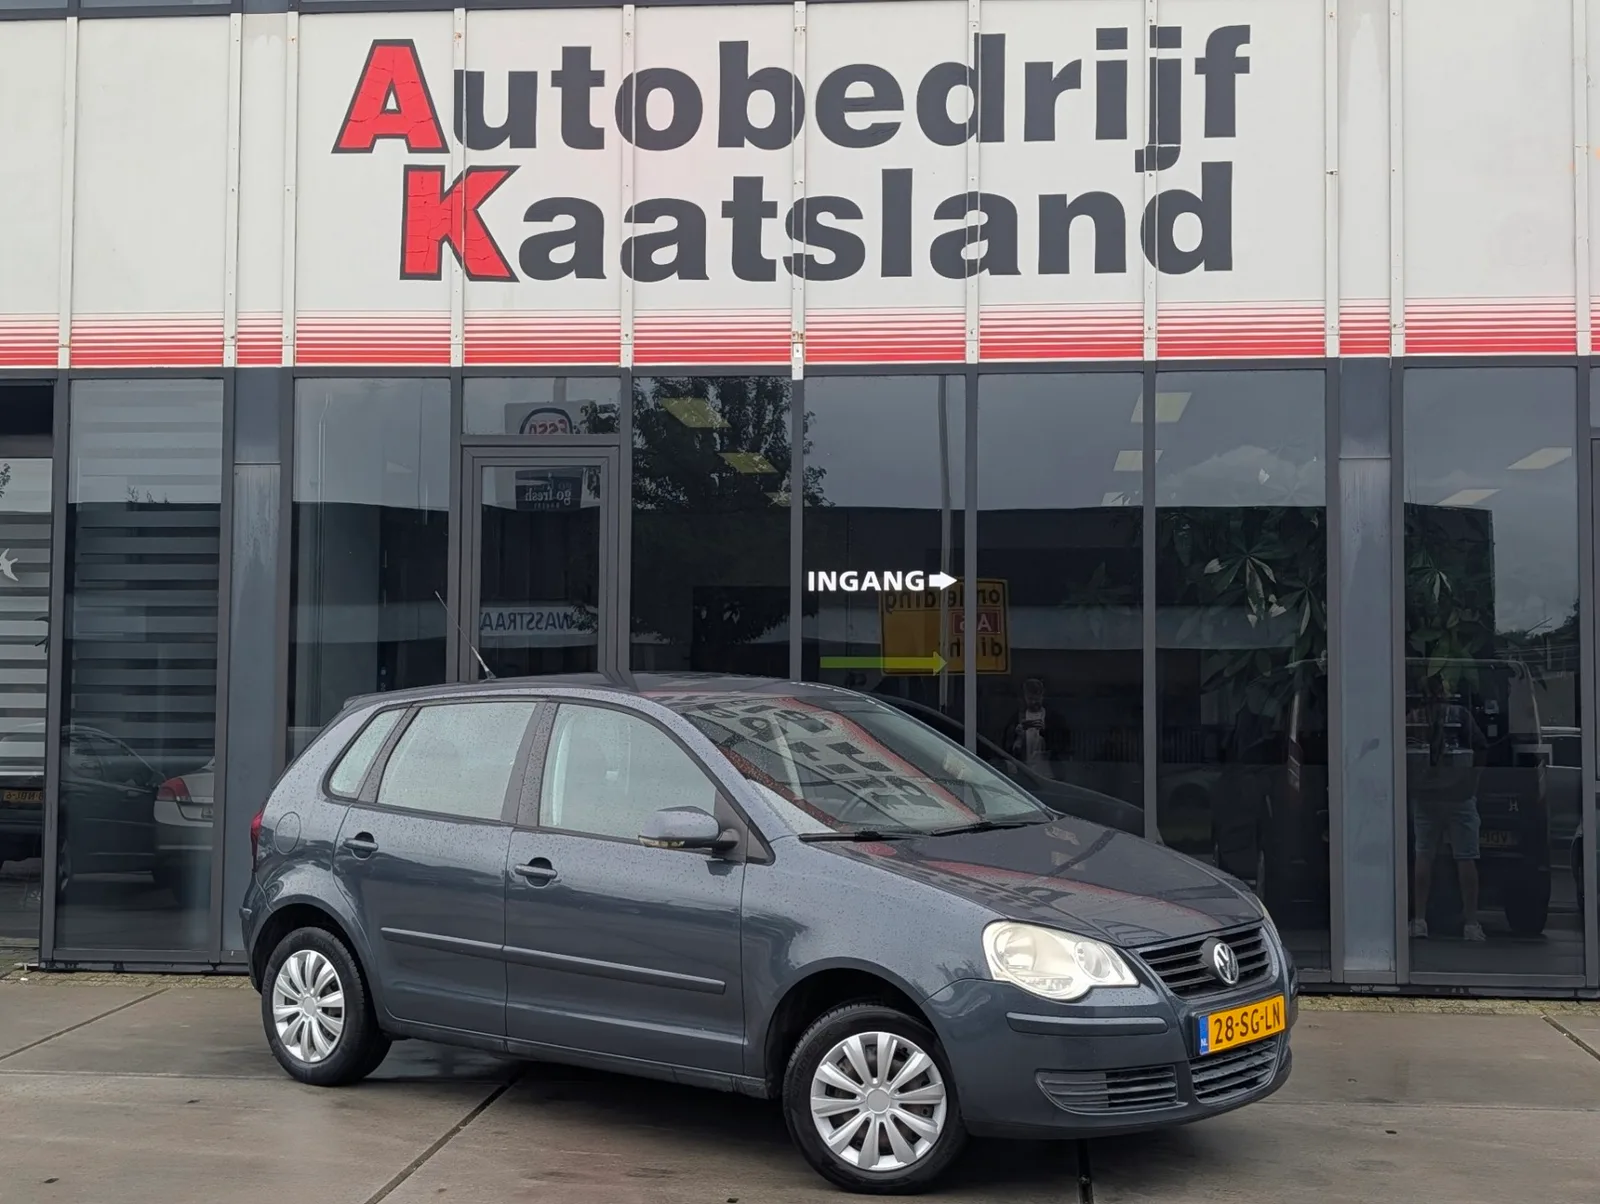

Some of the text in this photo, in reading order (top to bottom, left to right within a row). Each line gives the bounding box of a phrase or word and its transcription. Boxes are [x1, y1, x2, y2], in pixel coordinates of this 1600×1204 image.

[331, 25, 1251, 173] Autobedrijf
[400, 161, 1233, 283] Kaatsland
[807, 570, 925, 592] INGANG
[1213, 1001, 1281, 1045] 28-SG-LN
